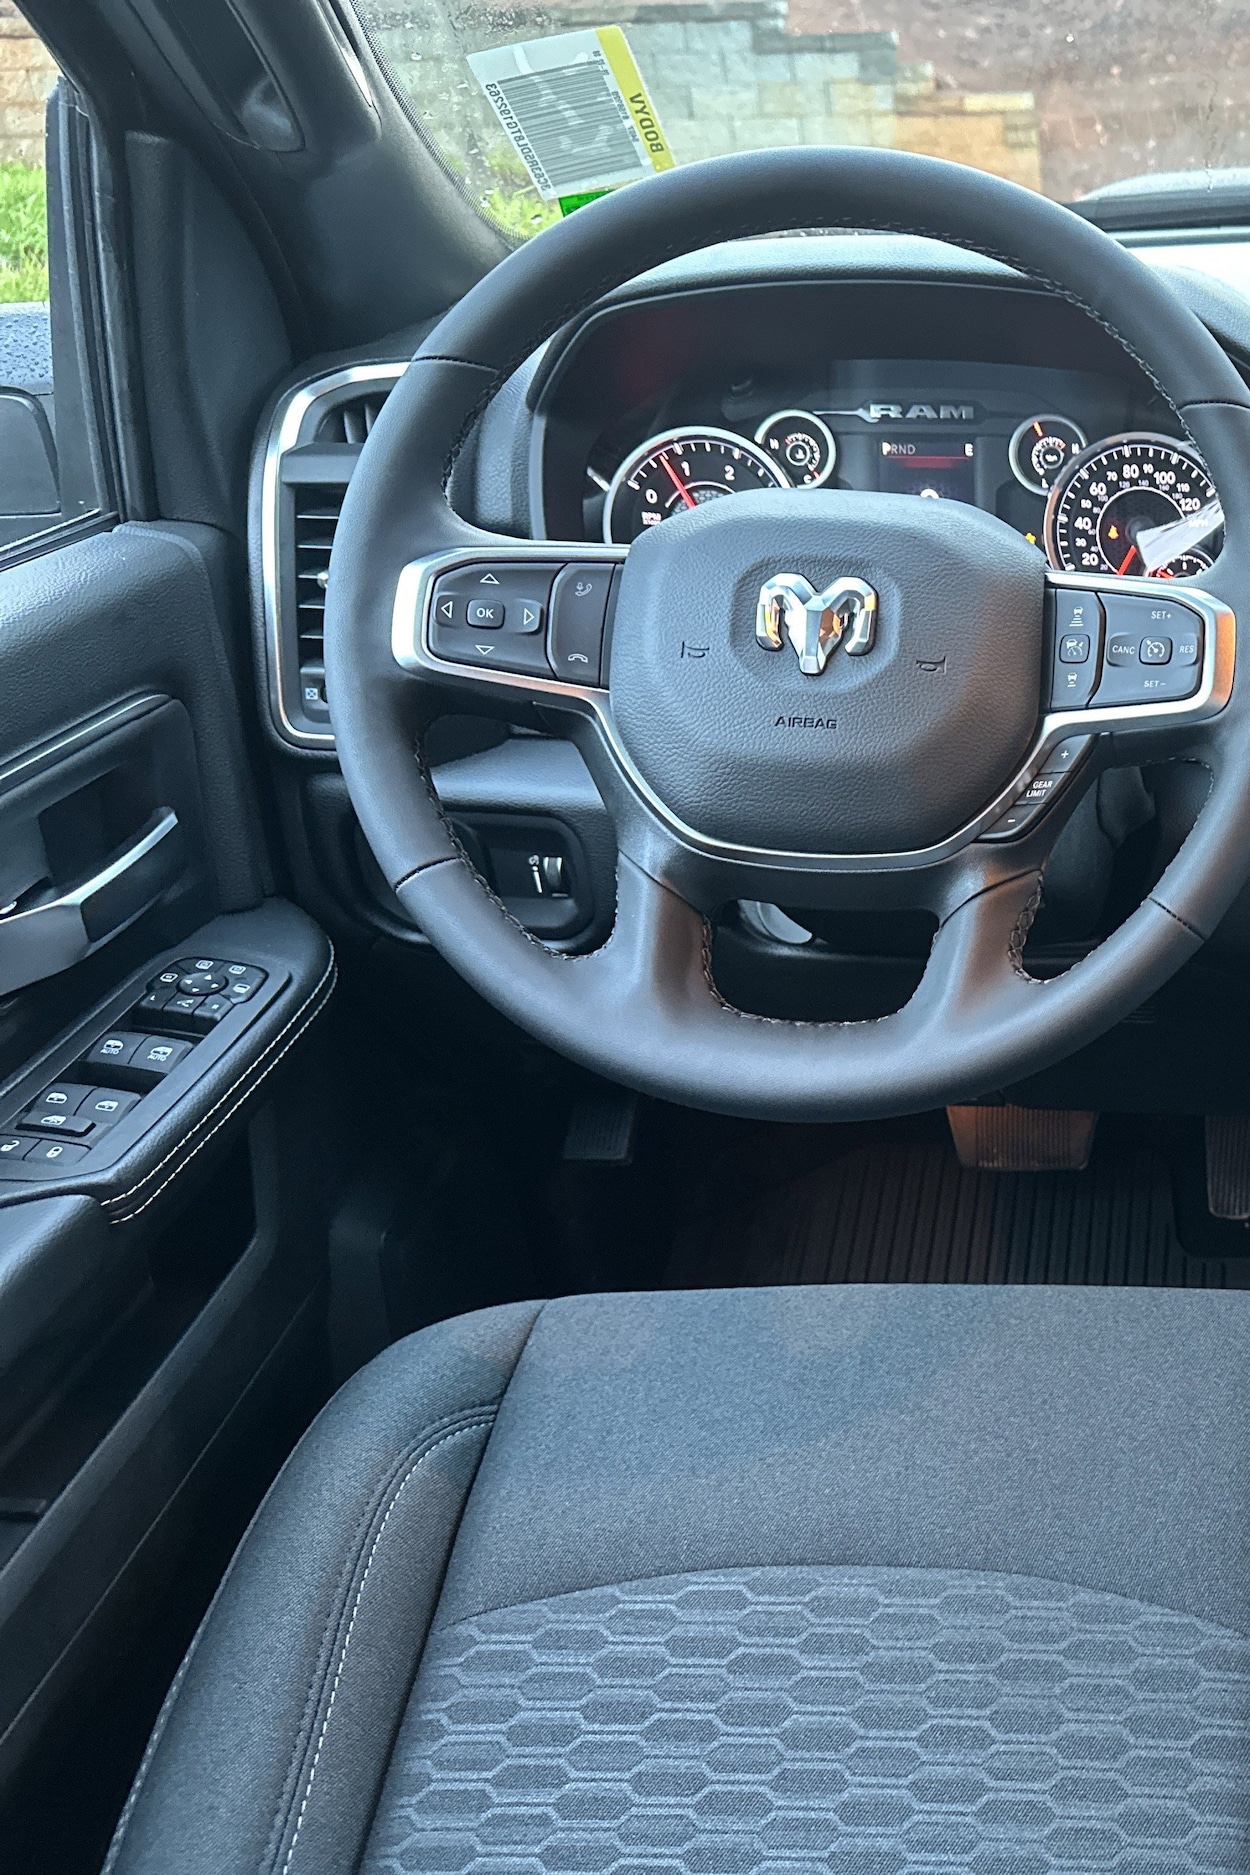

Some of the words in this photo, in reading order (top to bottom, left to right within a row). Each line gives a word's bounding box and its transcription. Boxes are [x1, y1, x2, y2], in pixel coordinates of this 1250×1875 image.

[869, 403, 975, 420] RAM
[681, 461, 691, 477] 1
[724, 465, 736, 481] 2
[1122, 464, 1140, 479] 80
[1143, 463, 1154, 474] 90
[1106, 471, 1118, 481] 70
[1153, 471, 1176, 485] 100
[1089, 482, 1107, 496] 60
[1176, 482, 1190, 493] 110
[645, 488, 658, 504] 0
[1080, 499, 1092, 509] 50
[1179, 498, 1201, 511] 120
[1074, 517, 1092, 530] 40
[1075, 538, 1087, 547] 30
[1081, 552, 1099, 566] 20
[476, 607, 494, 619] OK
[1112, 644, 1135, 655] CANC
[1179, 645, 1195, 654] RES
[774, 716, 837, 730] AIRBAG
[1032, 780, 1053, 789] GEAR
[1026, 790, 1047, 798] LIMIT
[147, 1054, 167, 1062] AUTO
